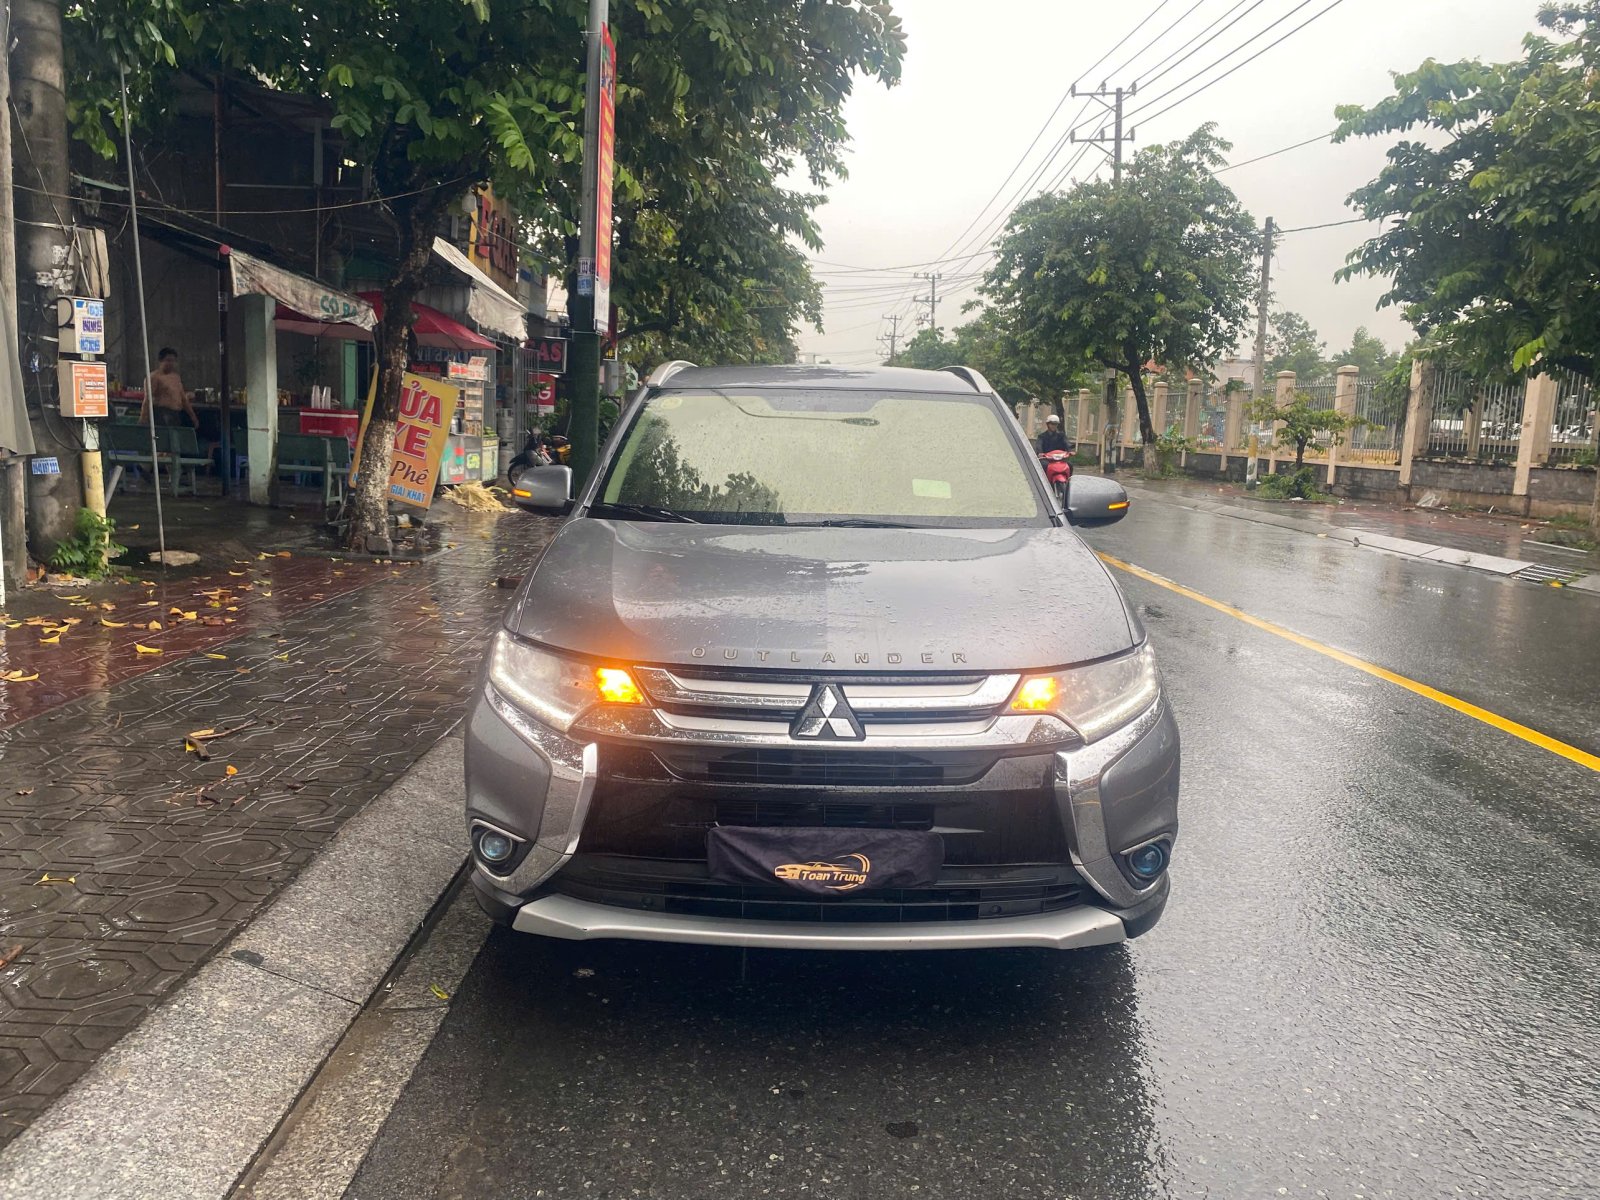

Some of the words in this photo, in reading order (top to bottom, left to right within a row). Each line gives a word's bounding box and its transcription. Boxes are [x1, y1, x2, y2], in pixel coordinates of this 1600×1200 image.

[390, 460, 429, 485] Phê
[690, 647, 967, 664] OUTLANDER
[801, 870, 830, 882] Toan
[832, 871, 867, 883] Trung
